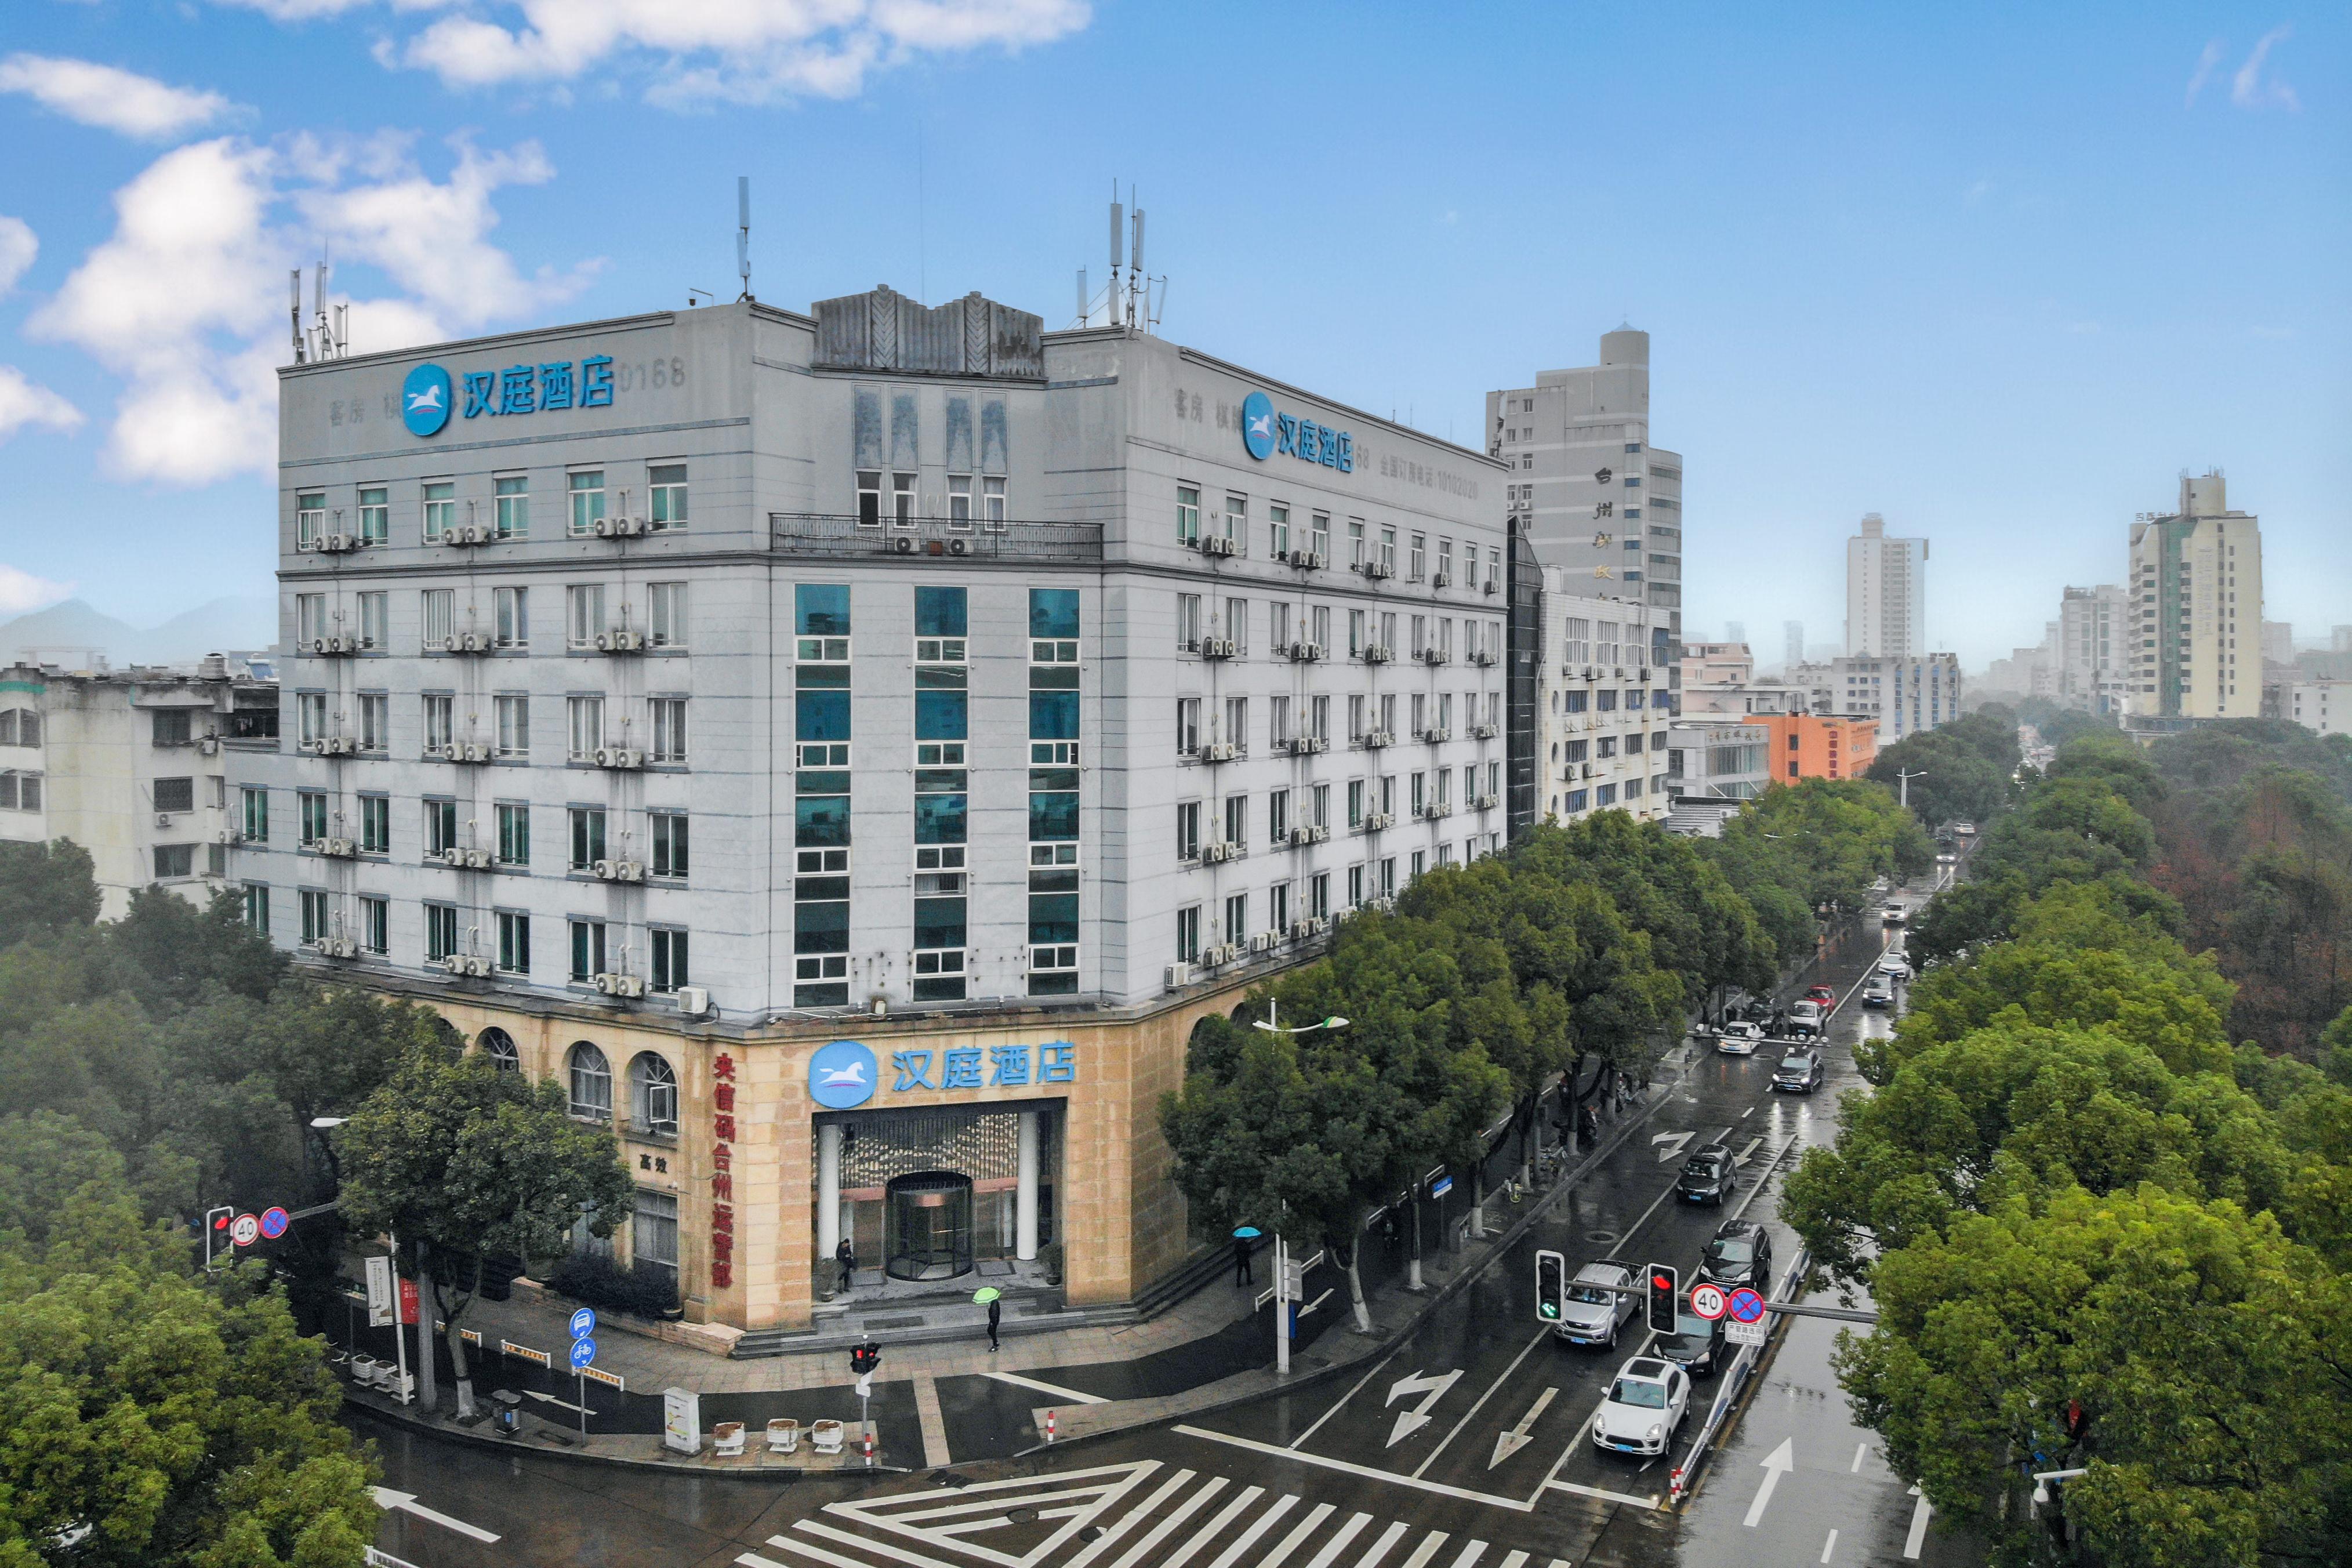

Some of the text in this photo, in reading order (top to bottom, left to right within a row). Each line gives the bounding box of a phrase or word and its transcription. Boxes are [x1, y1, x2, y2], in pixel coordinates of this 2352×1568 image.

[463, 354, 615, 418] 汉庭酒店
[1278, 411, 1355, 474] 汉庭酒店
[892, 1040, 1076, 1092] 汉庭酒店
[238, 1221, 255, 1237] 40
[1698, 1293, 1718, 1311] 40
